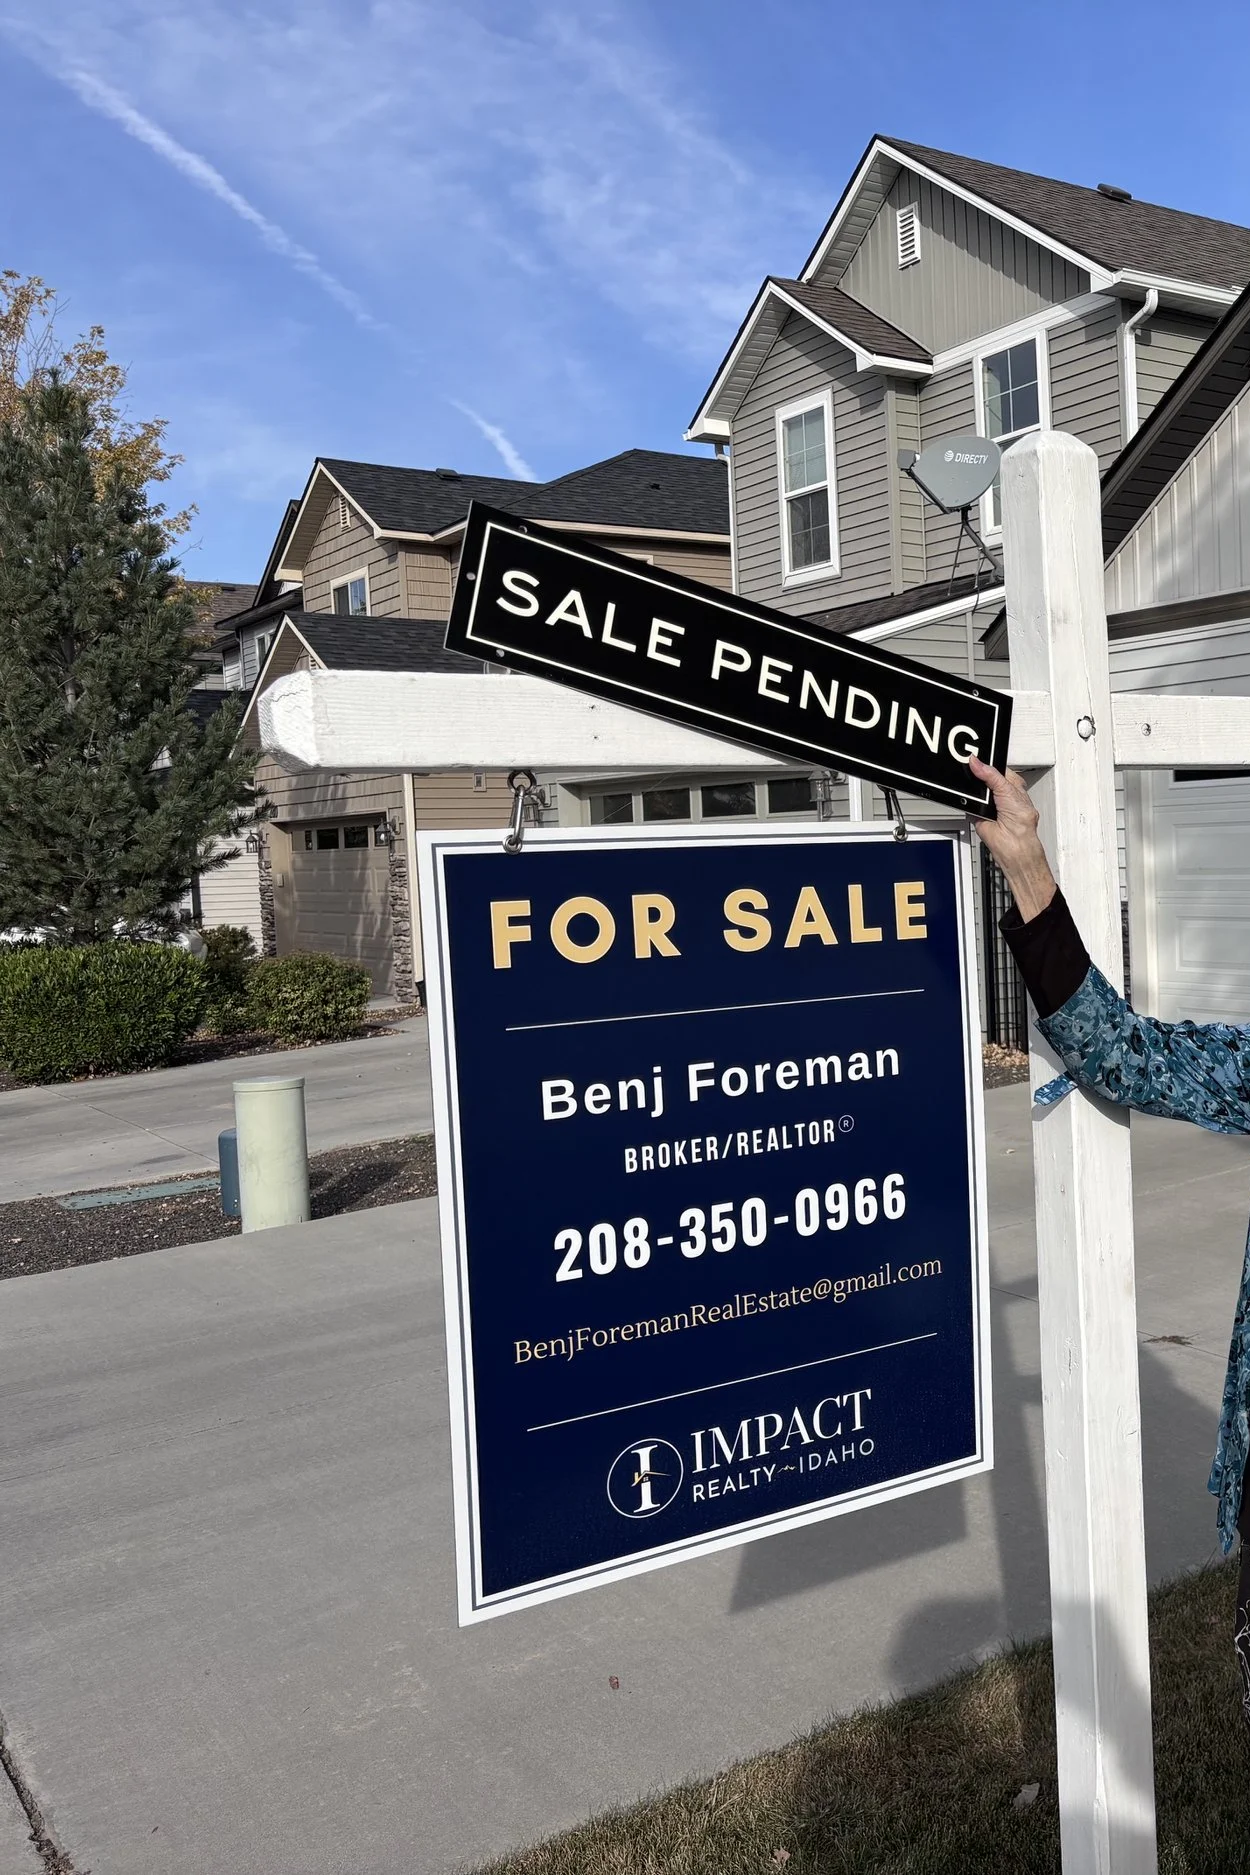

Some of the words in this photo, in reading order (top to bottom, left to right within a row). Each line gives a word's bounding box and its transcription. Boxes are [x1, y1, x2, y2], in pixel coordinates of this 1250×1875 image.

[954, 452, 989, 465] DIRECTV
[496, 570, 685, 667] SALE
[710, 639, 980, 765] PENDING
[489, 893, 682, 970] FOR
[723, 881, 928, 953] SALE
[541, 1065, 665, 1121] Benj
[687, 1047, 901, 1102] Foreman
[553, 1173, 907, 1283] 208-350-0966
[513, 1257, 943, 1365] BenjForemanRealEstate@gmail.com
[690, 1388, 872, 1474] IMPACT
[692, 1463, 777, 1503] REALTY
[799, 1438, 875, 1474] IDAHO
